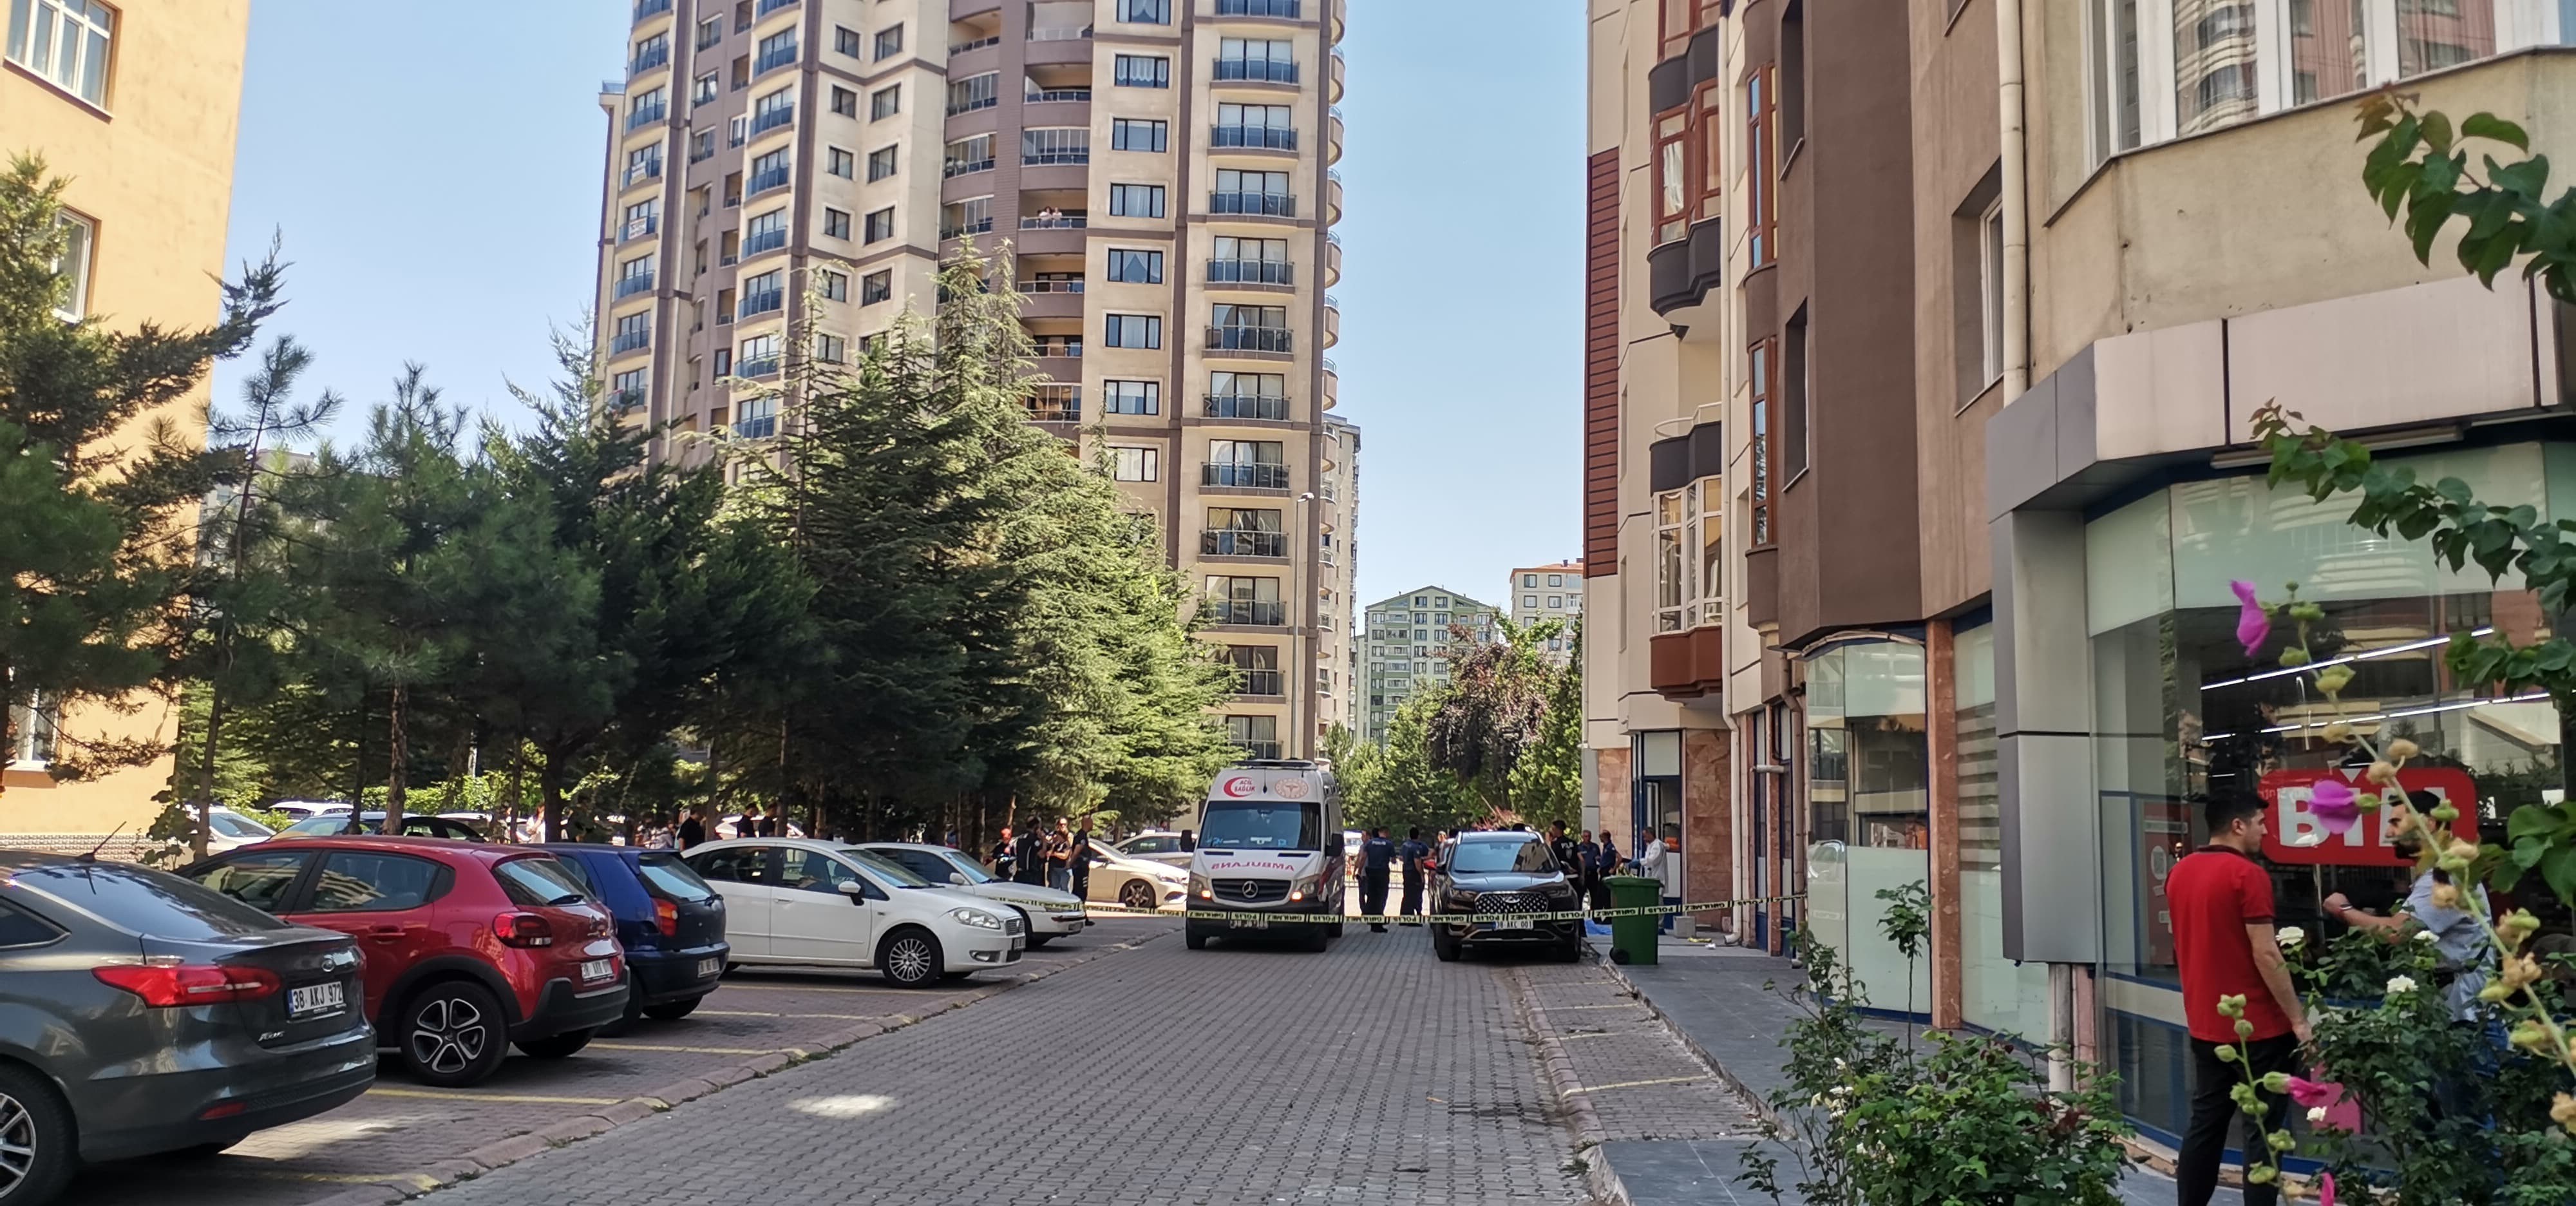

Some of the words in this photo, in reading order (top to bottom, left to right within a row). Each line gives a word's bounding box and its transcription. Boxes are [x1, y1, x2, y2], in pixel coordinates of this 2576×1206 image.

[293, 990, 305, 1010] 38
[310, 986, 325, 1007] AKJ
[328, 983, 343, 1003] 972
